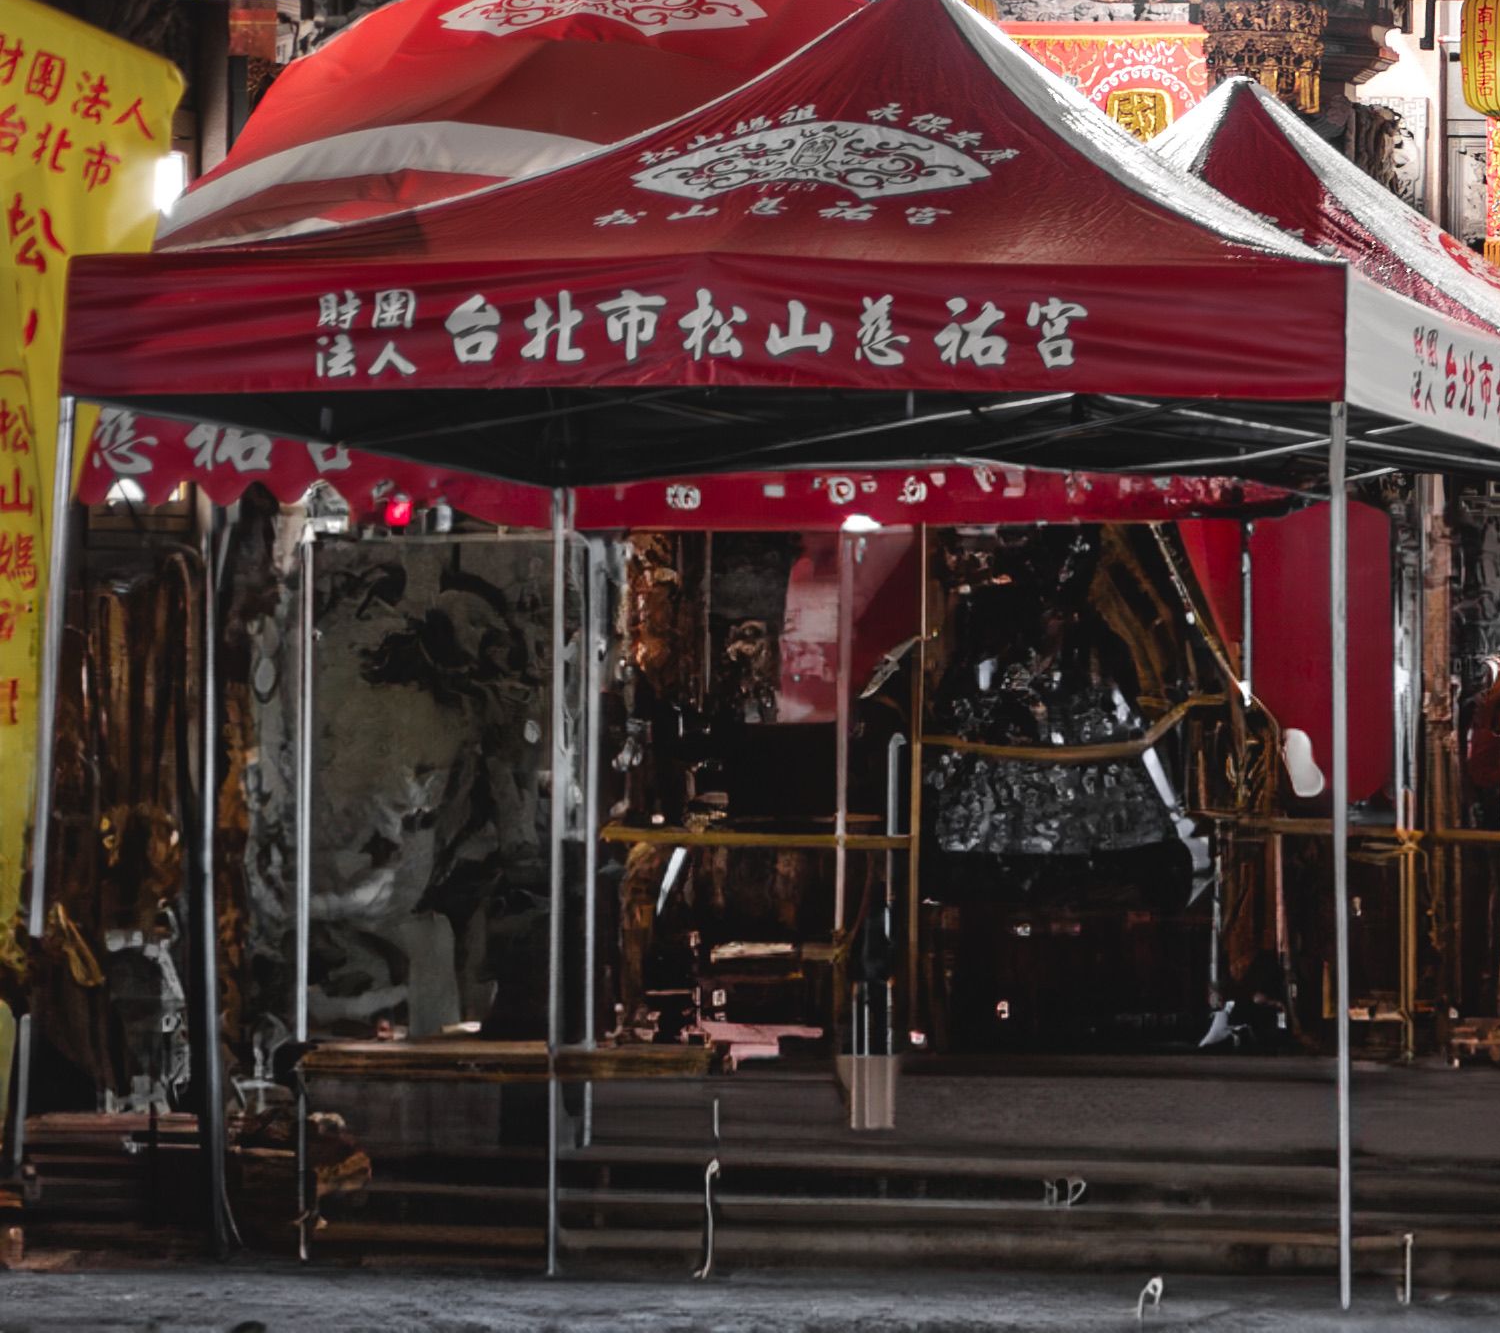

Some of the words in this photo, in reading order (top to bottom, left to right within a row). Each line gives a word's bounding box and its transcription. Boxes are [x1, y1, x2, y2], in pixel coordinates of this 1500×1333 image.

[593, 195, 954, 227] 松山慈祐宮
[317, 289, 416, 332] 財團
[443, 287, 1089, 370] 台北市松山慈祐宮
[315, 336, 417, 379] 法人
